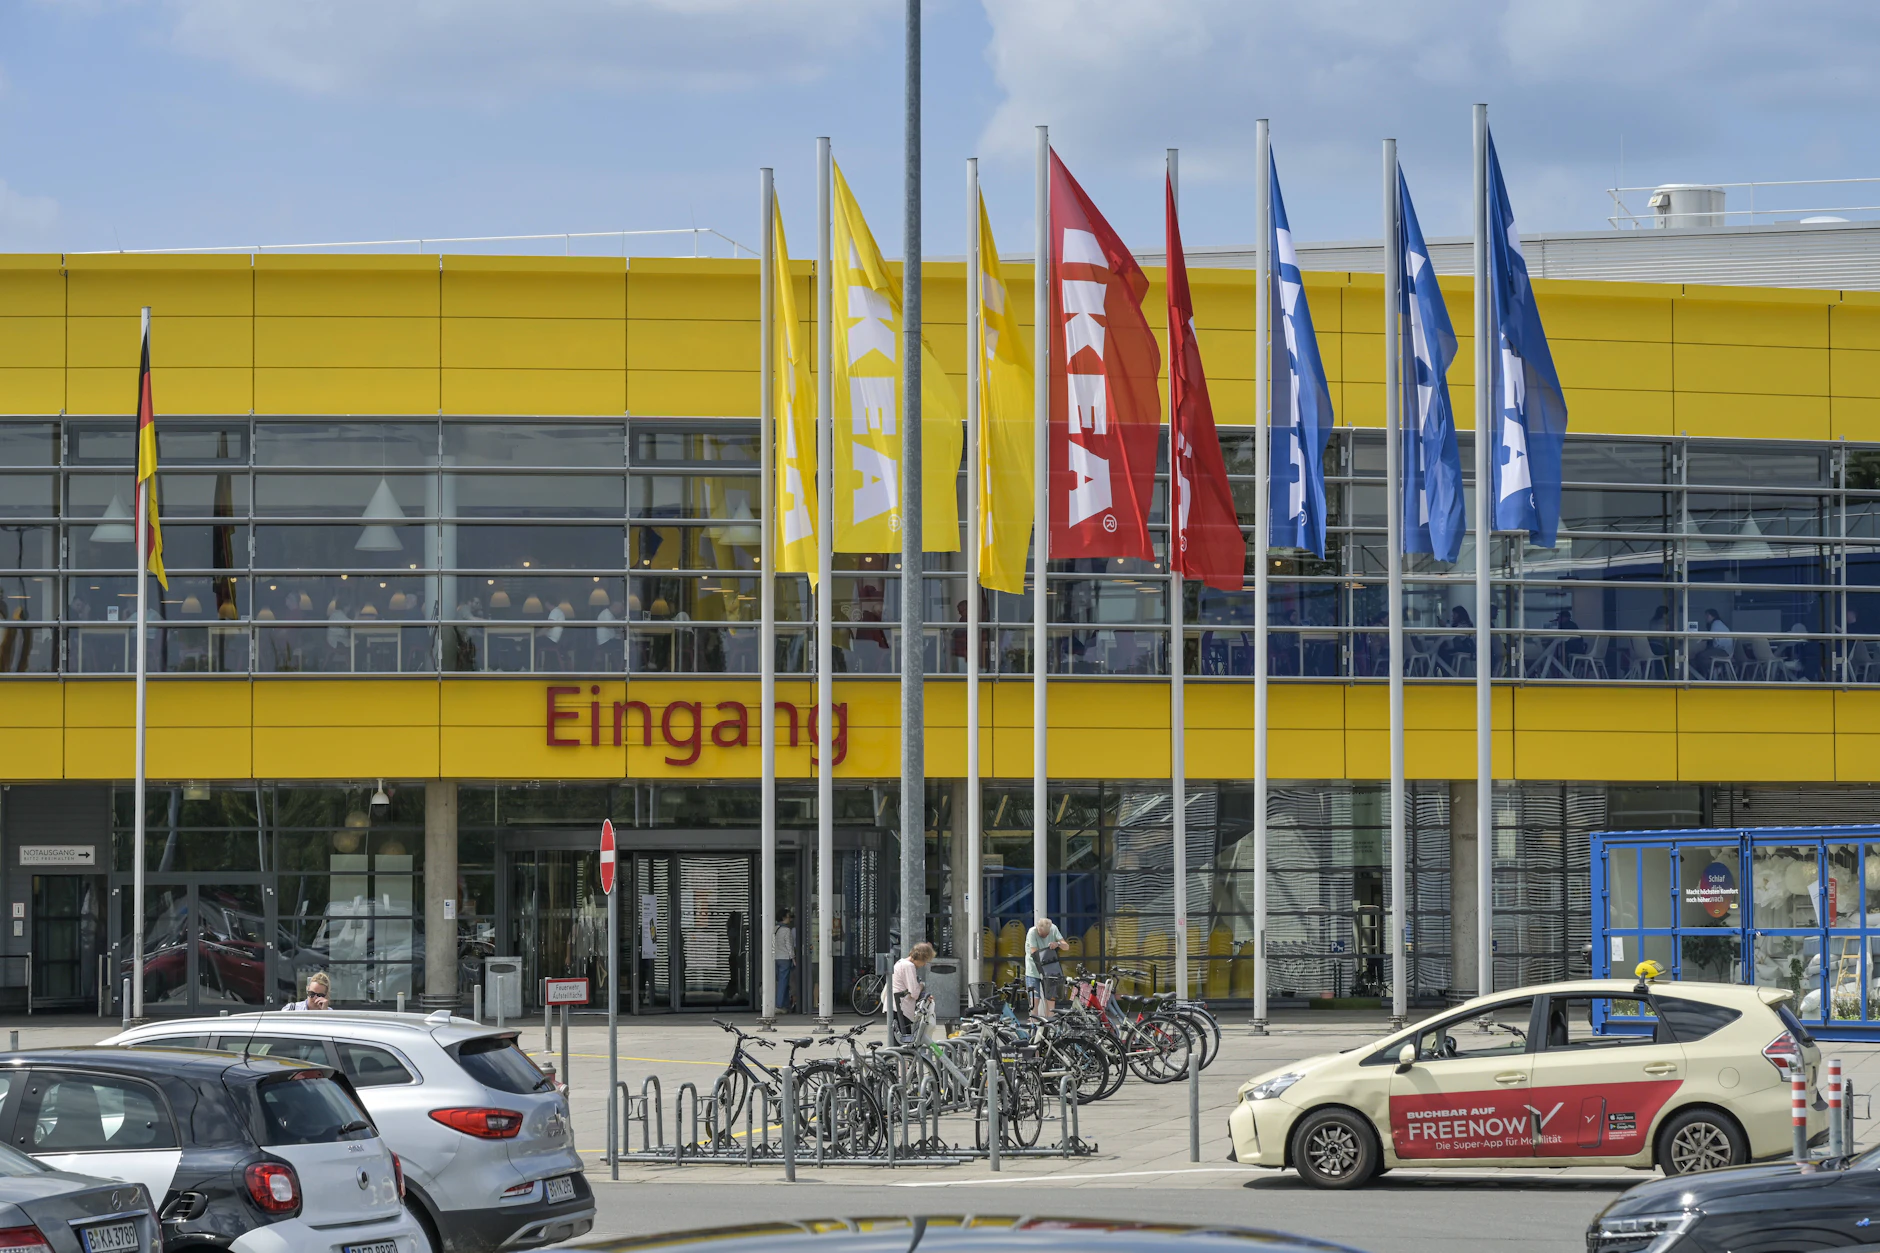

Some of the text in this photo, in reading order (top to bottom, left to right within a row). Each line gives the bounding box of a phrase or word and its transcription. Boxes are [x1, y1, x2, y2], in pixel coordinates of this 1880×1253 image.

[847, 237, 898, 525] KEA
[1062, 227, 1113, 528] IKEA
[547, 685, 847, 766] Eingang
[1407, 1107, 1496, 1119] BUCHBAR AUF
[1408, 1116, 1527, 1141] FREENOW
[1436, 1135, 1562, 1150] Die Super-App für Moilität
[88, 1231, 97, 1250] B
[113, 1226, 135, 1246] 3789
